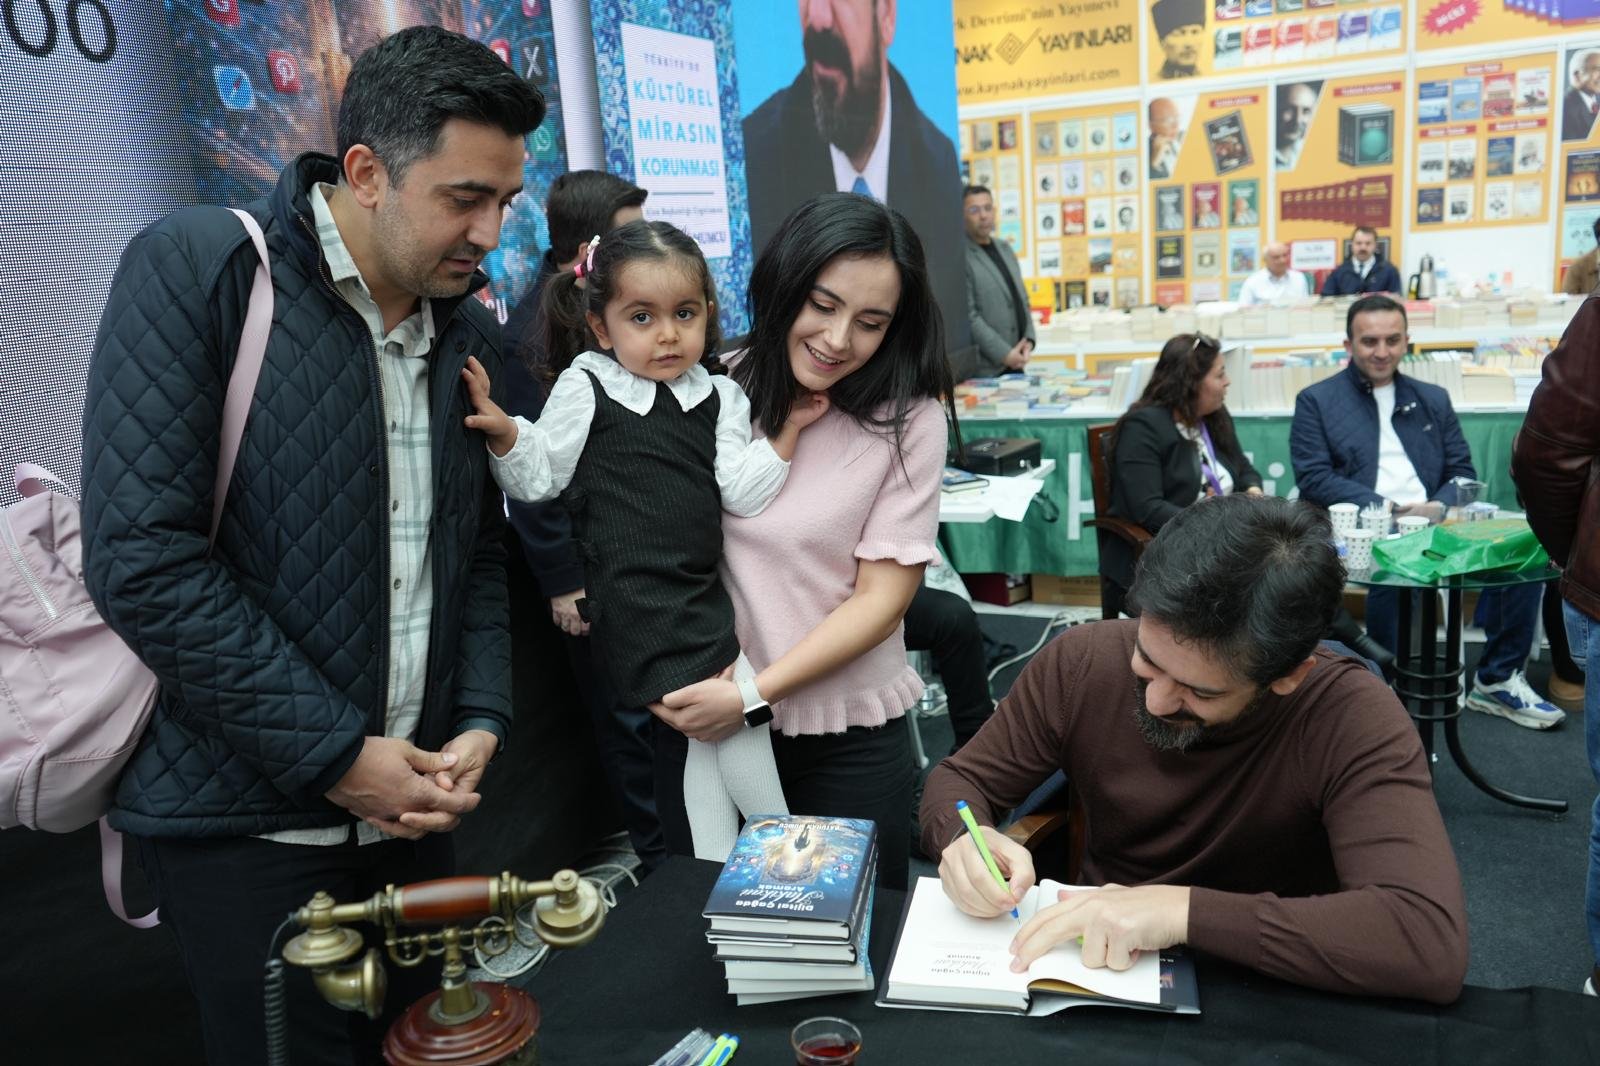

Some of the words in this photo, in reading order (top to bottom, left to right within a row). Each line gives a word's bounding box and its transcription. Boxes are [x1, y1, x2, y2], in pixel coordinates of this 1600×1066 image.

[1038, 24, 1133, 54] YAYINLARI
[633, 78, 714, 108] KÜLTÜREL
[637, 115, 717, 144] MİRASIN
[641, 157, 720, 177] KORUNMASI
[758, 884, 805, 892] Aramak
[735, 899, 775, 910] Çağda
[777, 902, 815, 912] Dijital
